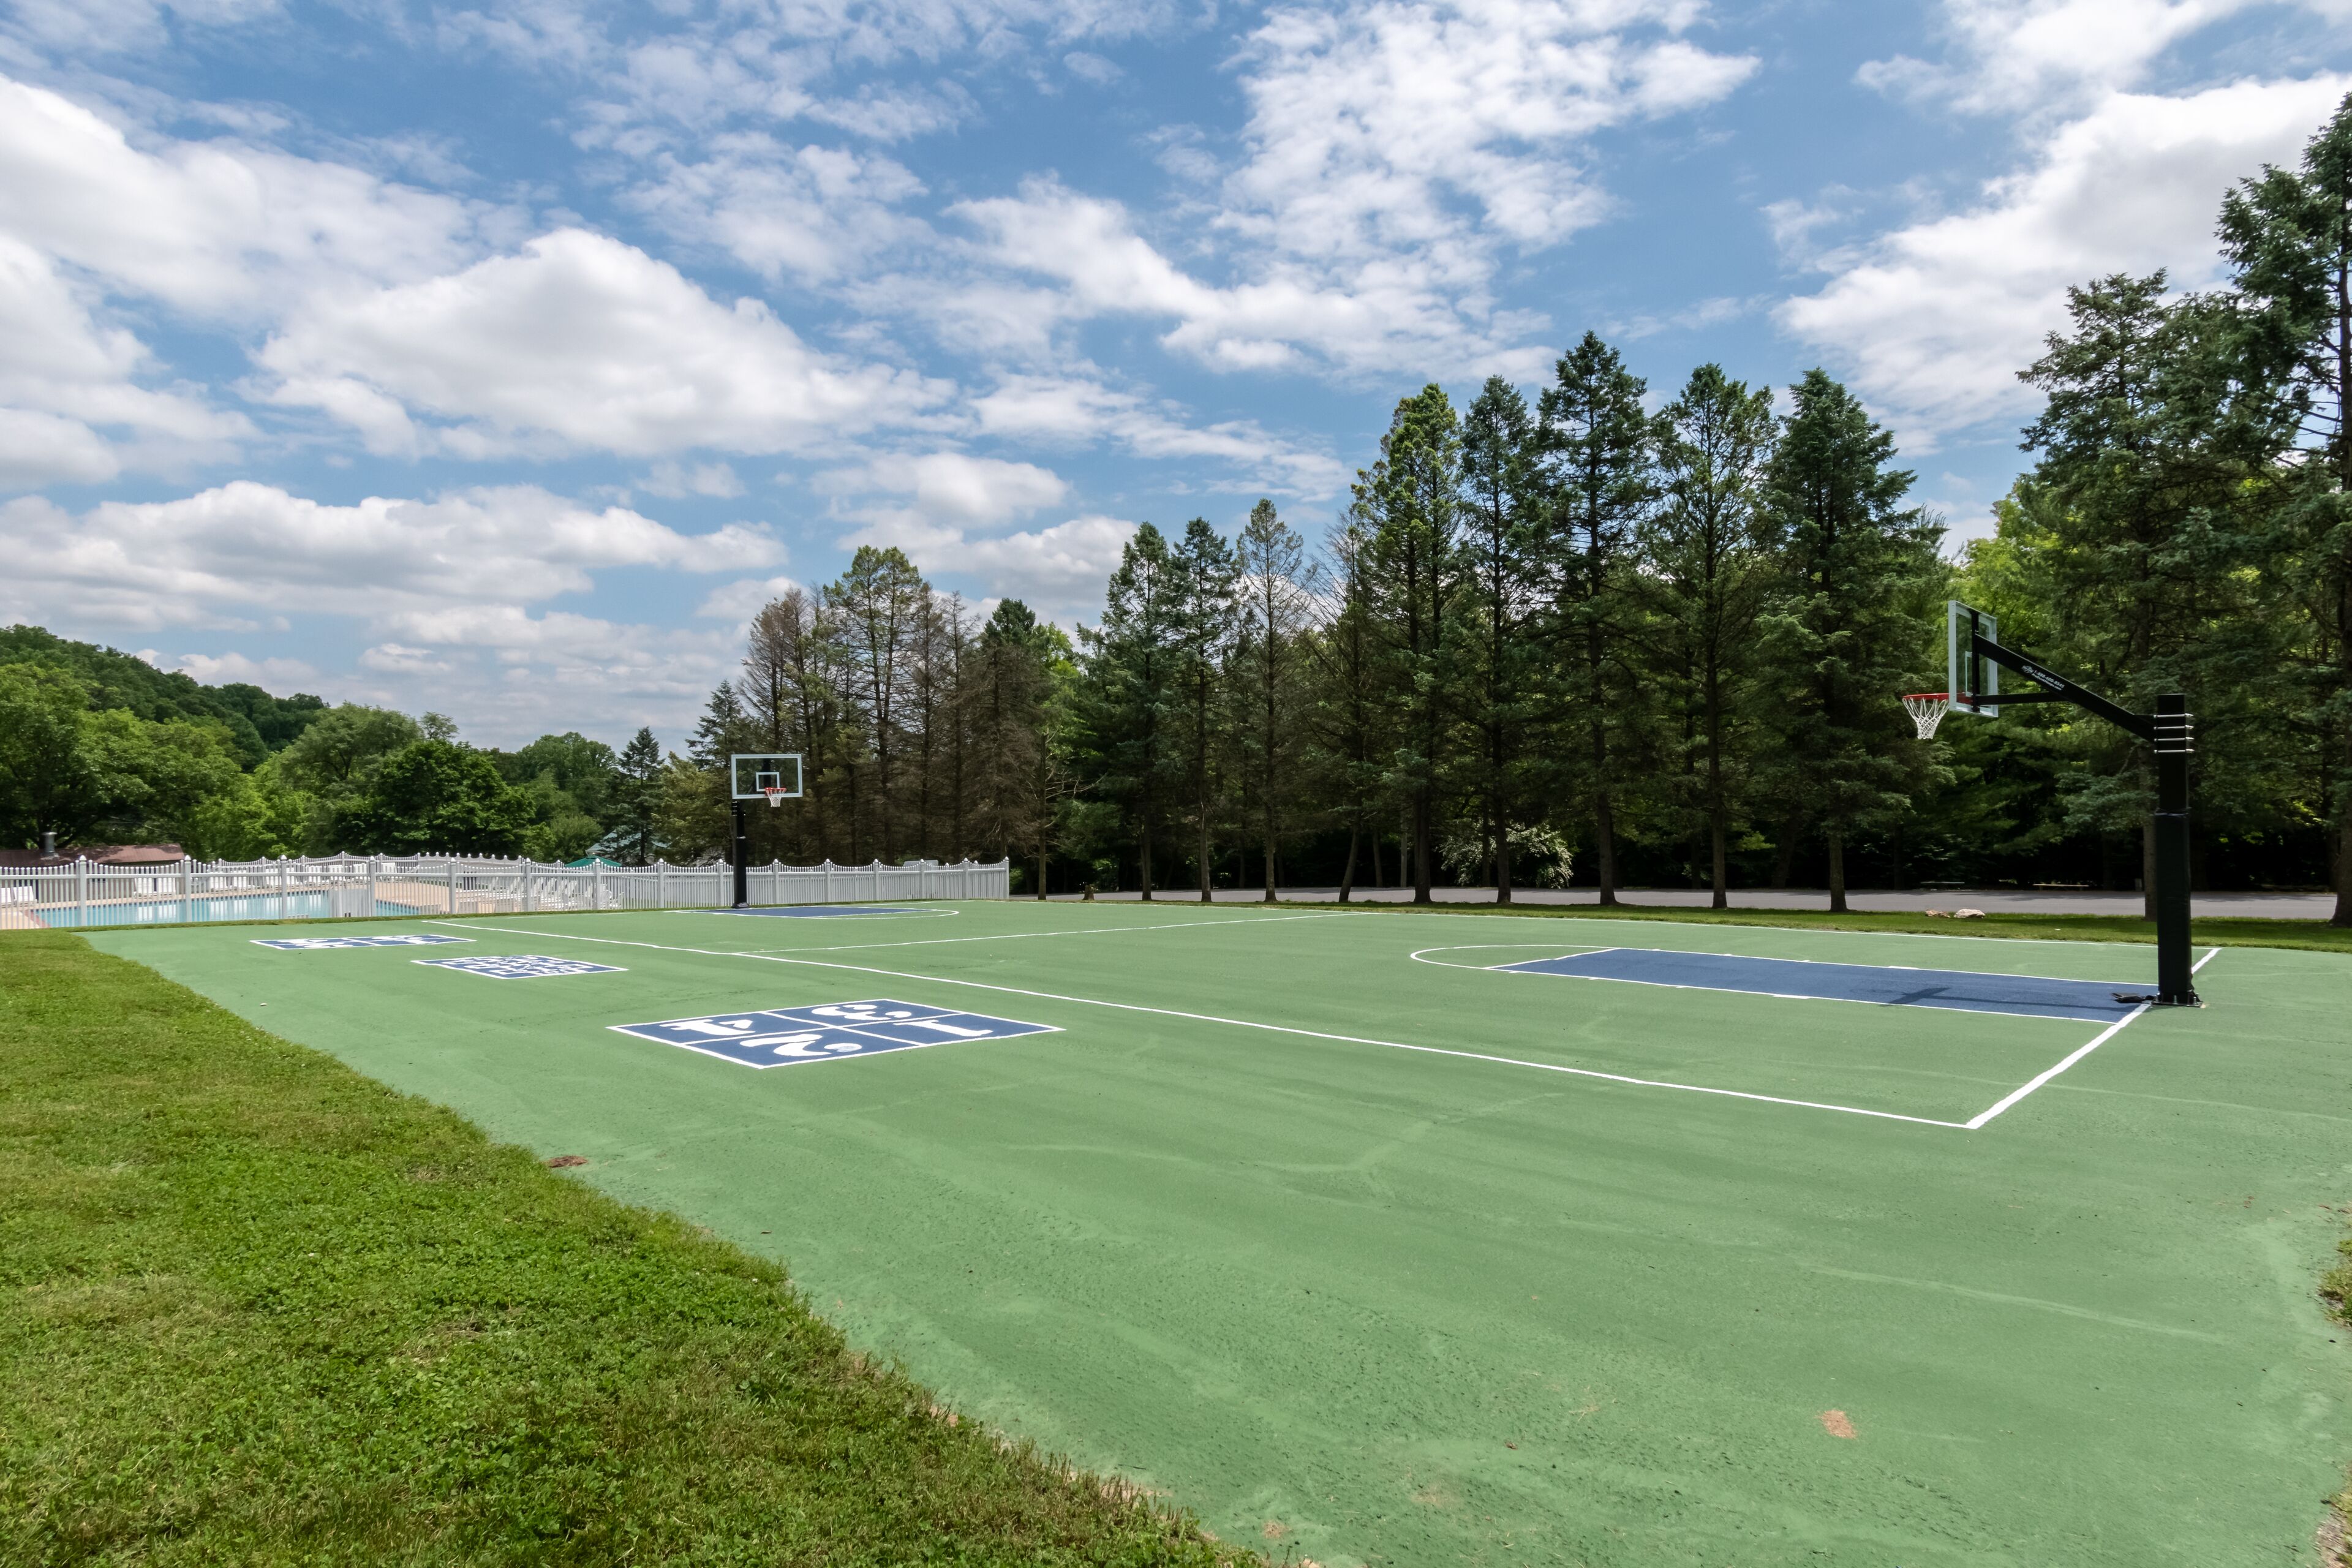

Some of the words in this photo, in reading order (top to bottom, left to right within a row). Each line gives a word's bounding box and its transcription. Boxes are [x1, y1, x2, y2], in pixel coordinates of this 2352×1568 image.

[811, 1005, 911, 1020] 3
[660, 1018, 755, 1036] 4
[892, 1019, 993, 1037] 1
[739, 1033, 862, 1057] 2
